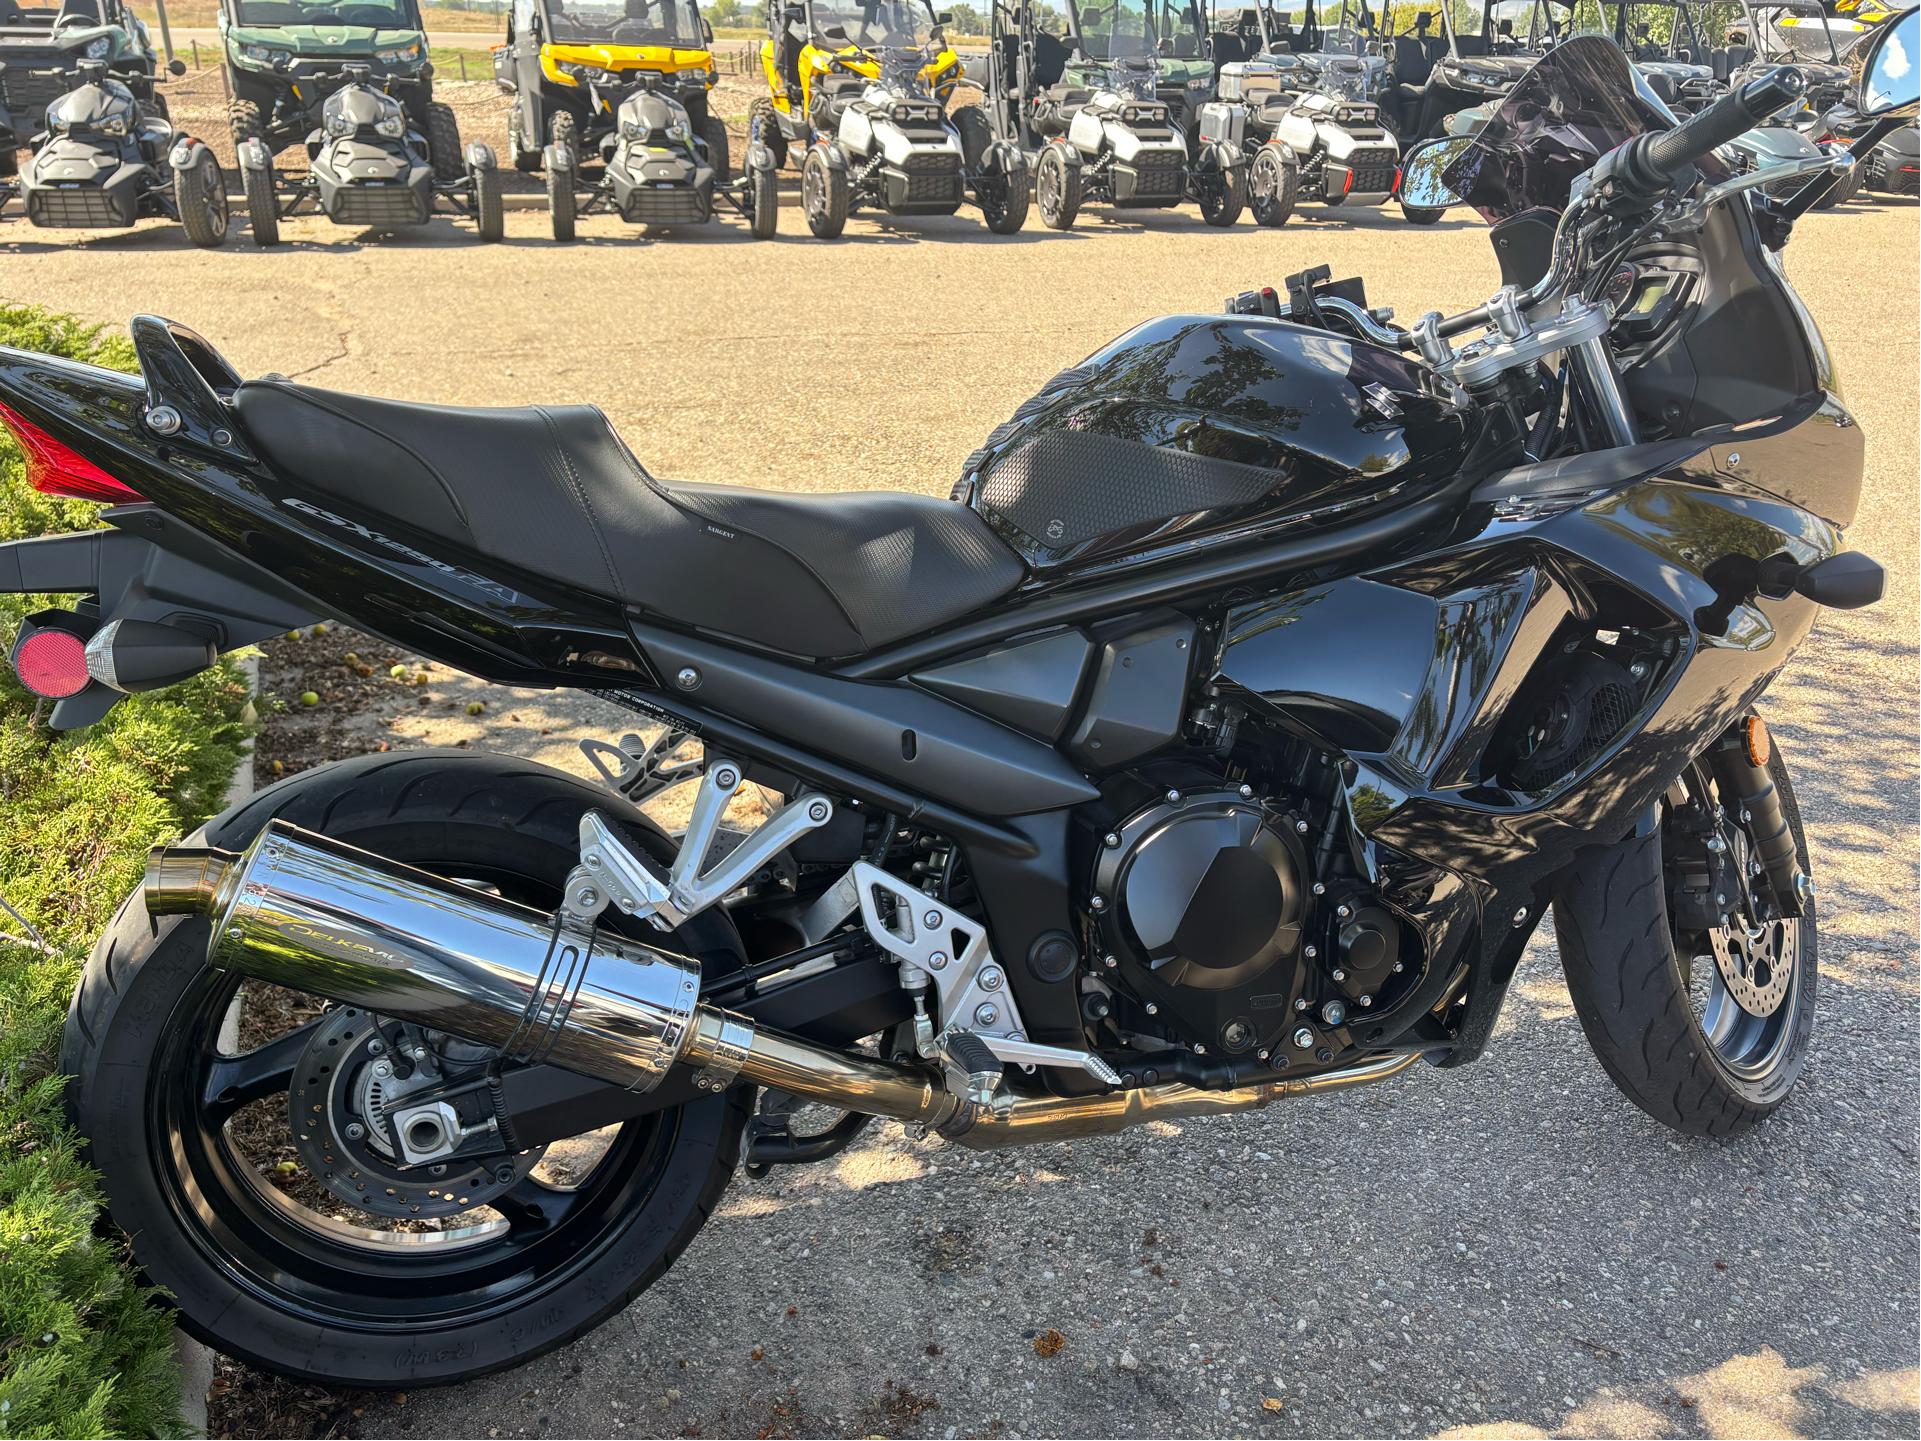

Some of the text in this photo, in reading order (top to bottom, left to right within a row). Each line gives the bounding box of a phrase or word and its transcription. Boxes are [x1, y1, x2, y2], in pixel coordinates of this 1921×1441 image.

[707, 525, 735, 539] SARGENT
[613, 689, 631, 699] MOTOR
[631, 696, 665, 713] CORPORATION
[122, 939, 195, 1038] KENDA
